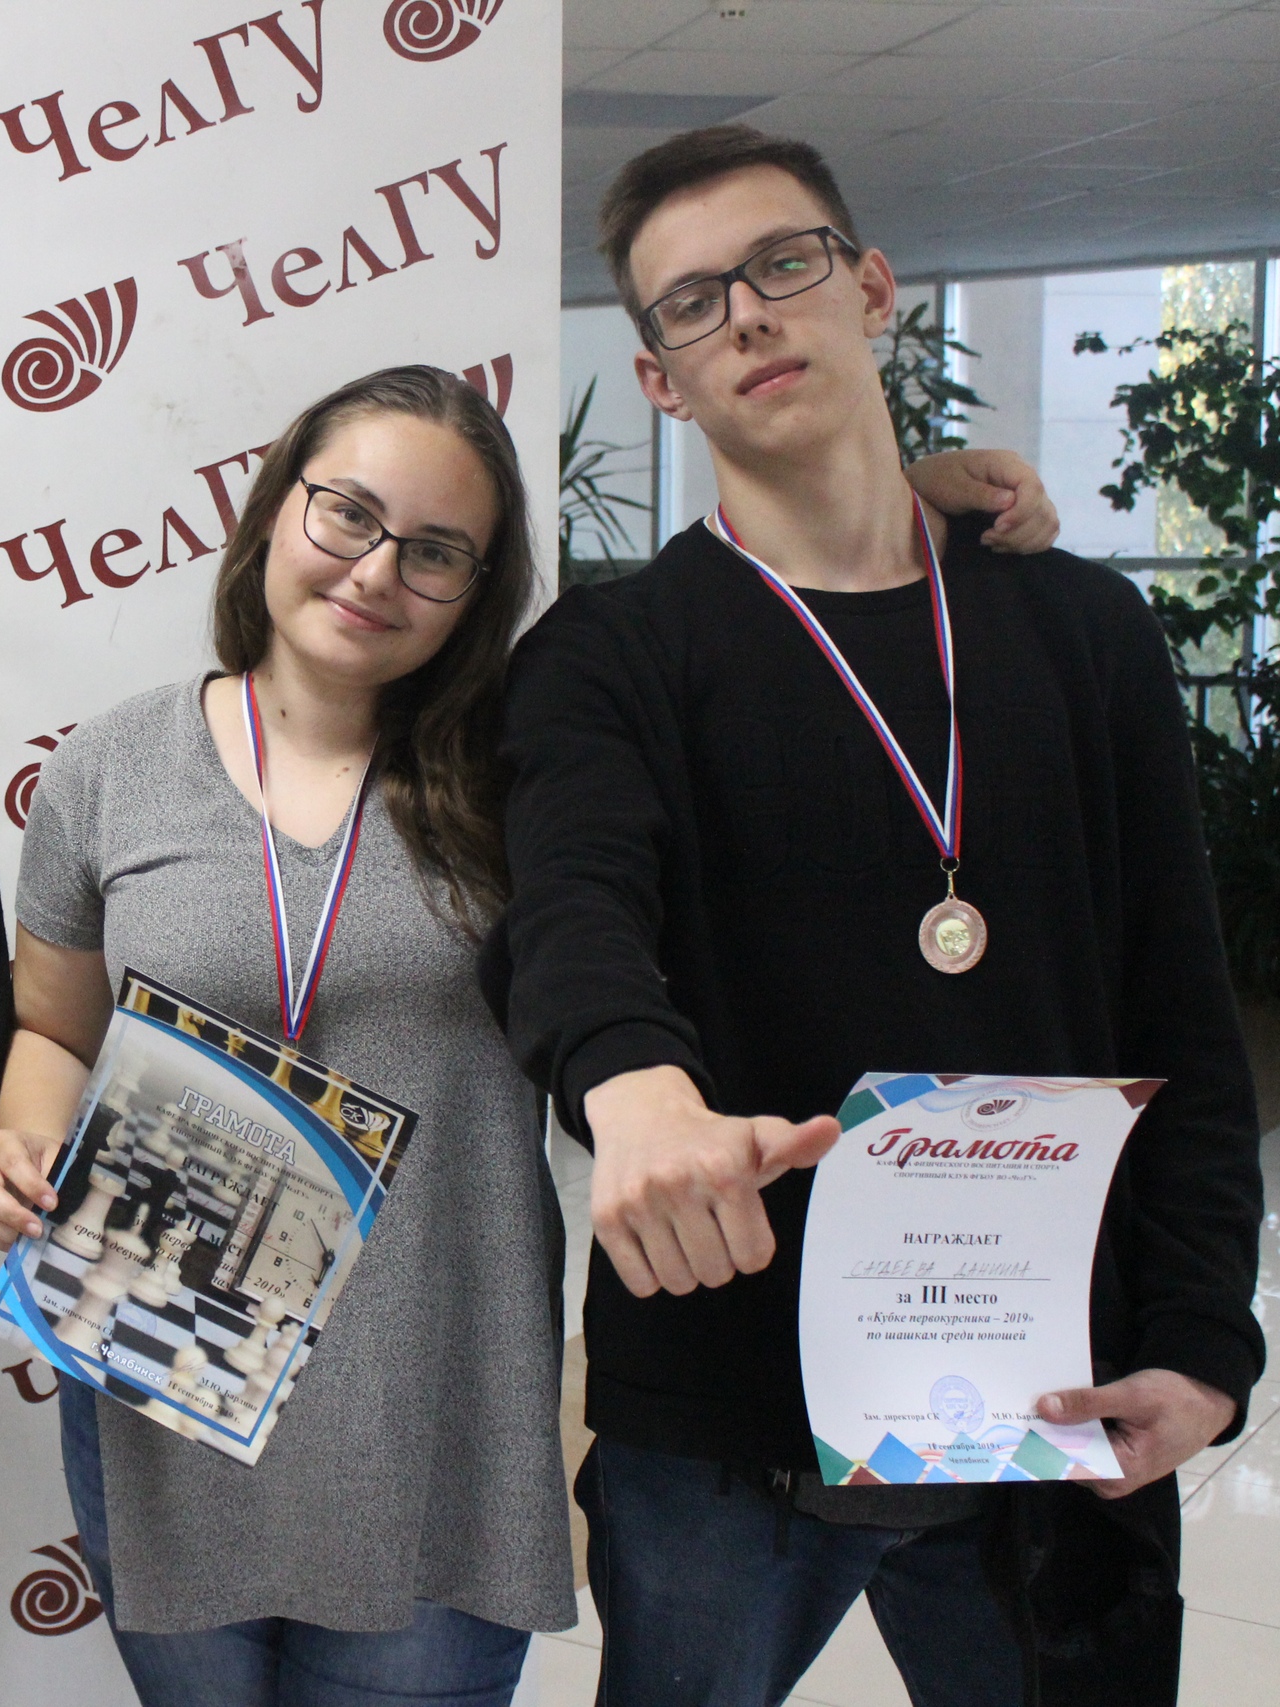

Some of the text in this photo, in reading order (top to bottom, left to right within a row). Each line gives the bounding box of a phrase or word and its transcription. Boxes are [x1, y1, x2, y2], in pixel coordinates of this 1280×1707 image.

[177, 142, 508, 326] ЧелГУ
[340, 1108, 363, 1122] СК
[177, 1086, 296, 1166] ГРАМОТА
[867, 1127, 1080, 1170] Грамота
[894, 1171, 946, 1179] СПОРТИВНЫЙ
[303, 1179, 335, 1200] СПОРТА
[293, 1208, 305, 1221] 10
[279, 1230, 289, 1242] 9
[903, 1232, 1003, 1246] НАГРАЖДАЕТ
[74, 1224, 106, 1245] среди
[109, 1240, 160, 1272] девушк
[273, 1256, 283, 1267] 8
[253, 1277, 286, 1299] 2019»
[284, 1280, 291, 1290] 7
[895, 1285, 998, 1305] за III место
[303, 1297, 312, 1308] 6
[60, 1305, 101, 1331] директора
[867, 1311, 907, 1325] «Кубке
[909, 1314, 991, 1326] первокурсника
[1002, 1312, 1034, 1323] 2019»
[867, 1330, 1026, 1343] по шашкам среди юношей
[90, 1341, 163, 1385] г.Челябинск
[177, 1386, 214, 1409] сентября
[863, 1412, 881, 1421] Зам.
[883, 1413, 925, 1423] директора
[926, 1412, 940, 1421] СК
[938, 1443, 976, 1451] сентября
[948, 1457, 990, 1465] Челябинск
